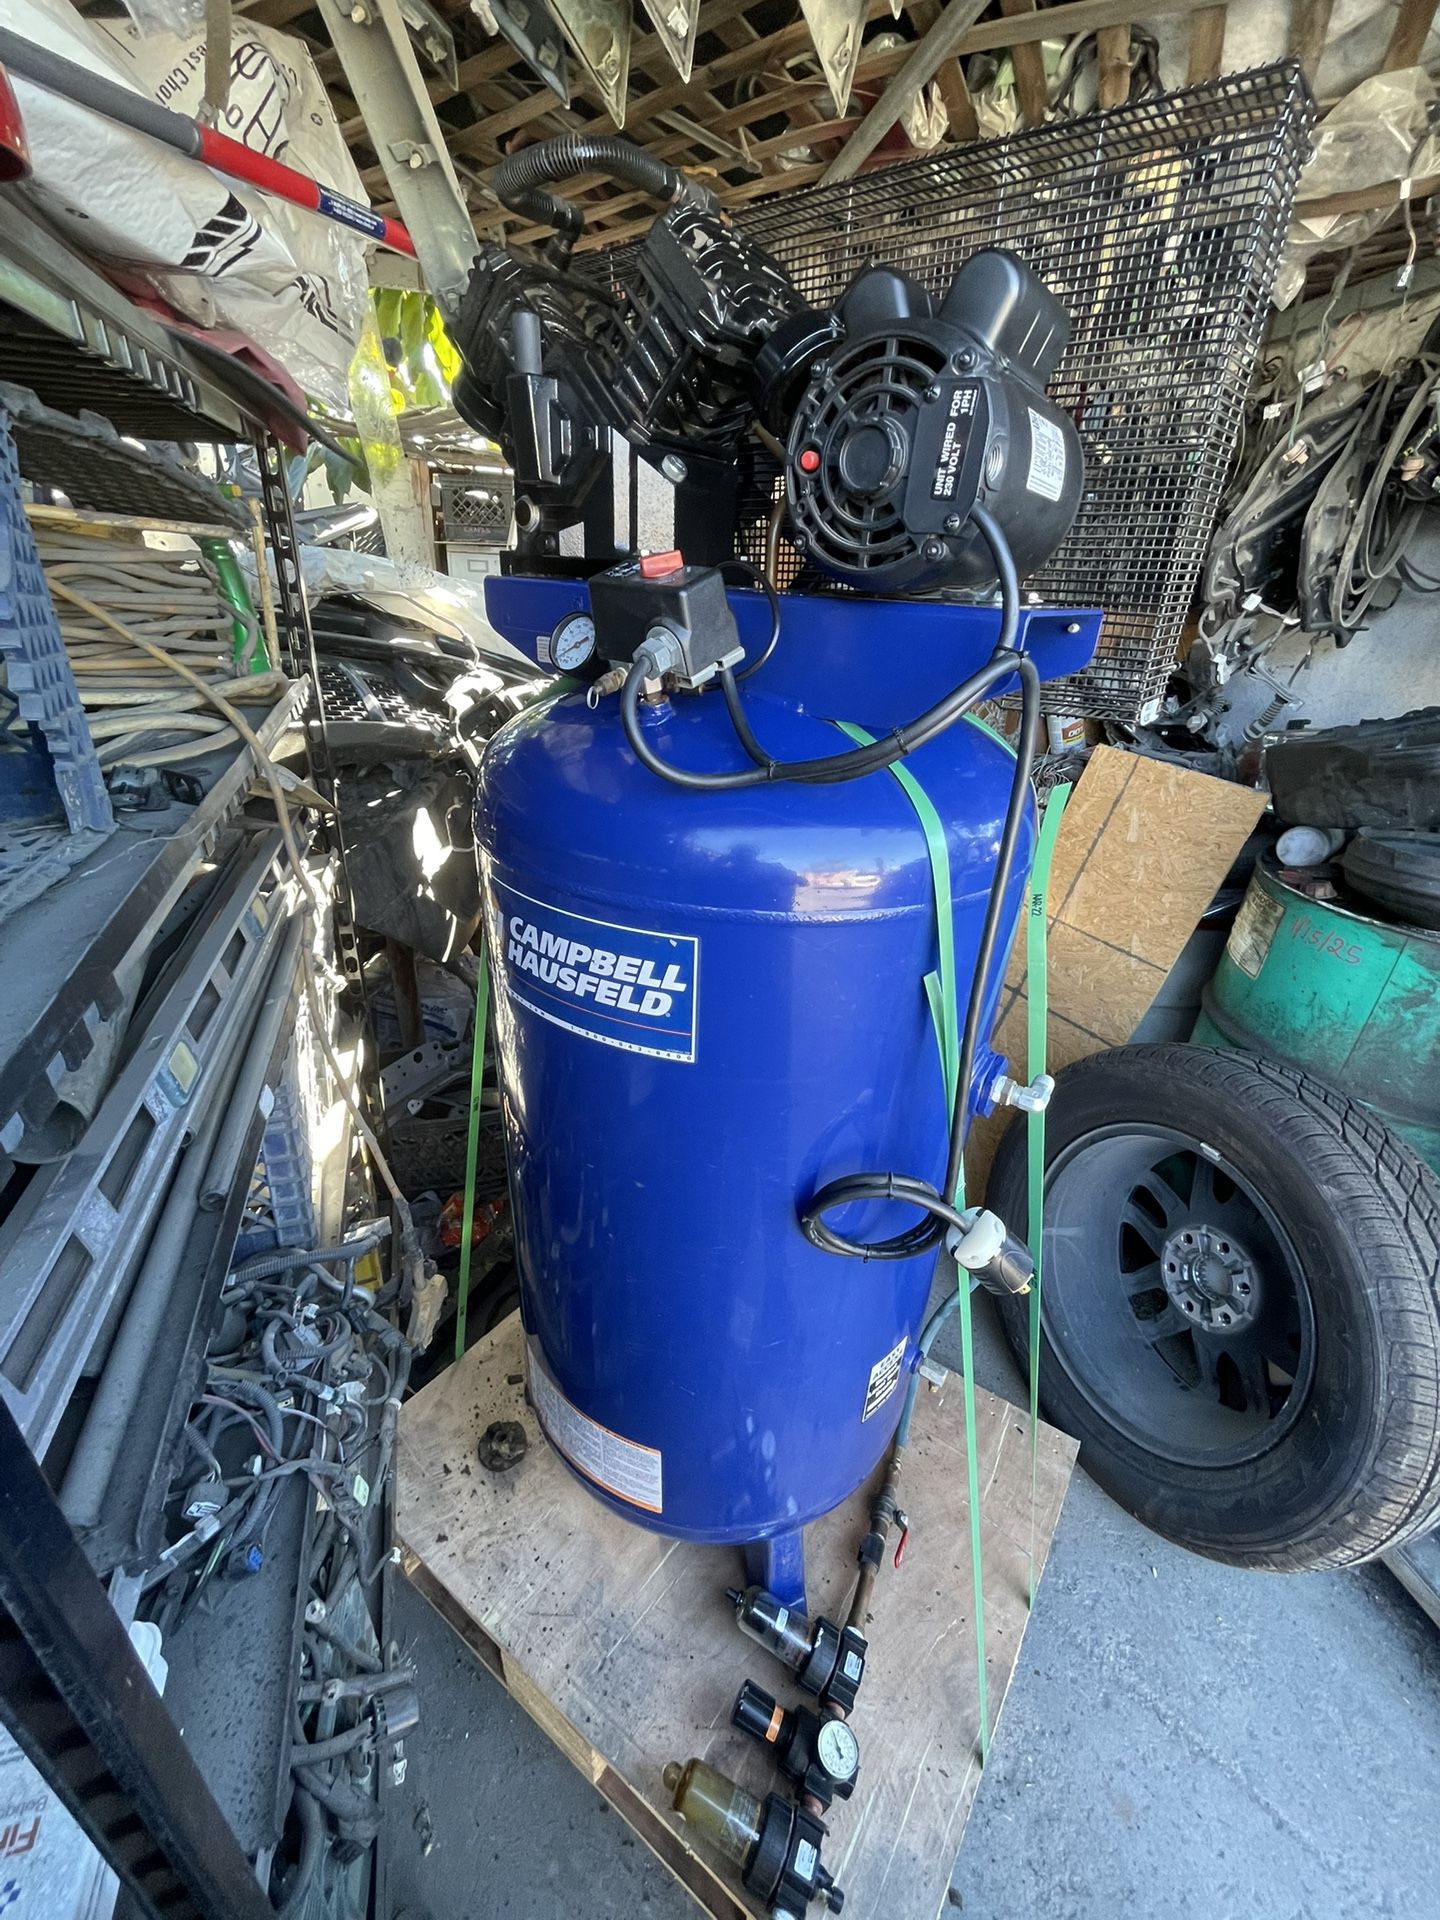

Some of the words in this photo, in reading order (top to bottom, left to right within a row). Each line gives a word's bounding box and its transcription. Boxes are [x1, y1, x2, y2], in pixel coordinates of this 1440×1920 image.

[960, 389, 973, 415] 1PH
[933, 467, 947, 496] UNIT
[940, 422, 956, 463] WIRED
[950, 389, 963, 418] FOR
[947, 443, 962, 473] VOLT
[943, 474, 955, 496] 230
[508, 939, 673, 1018] HAUSFELD
[509, 916, 687, 992] CAMPBELL
